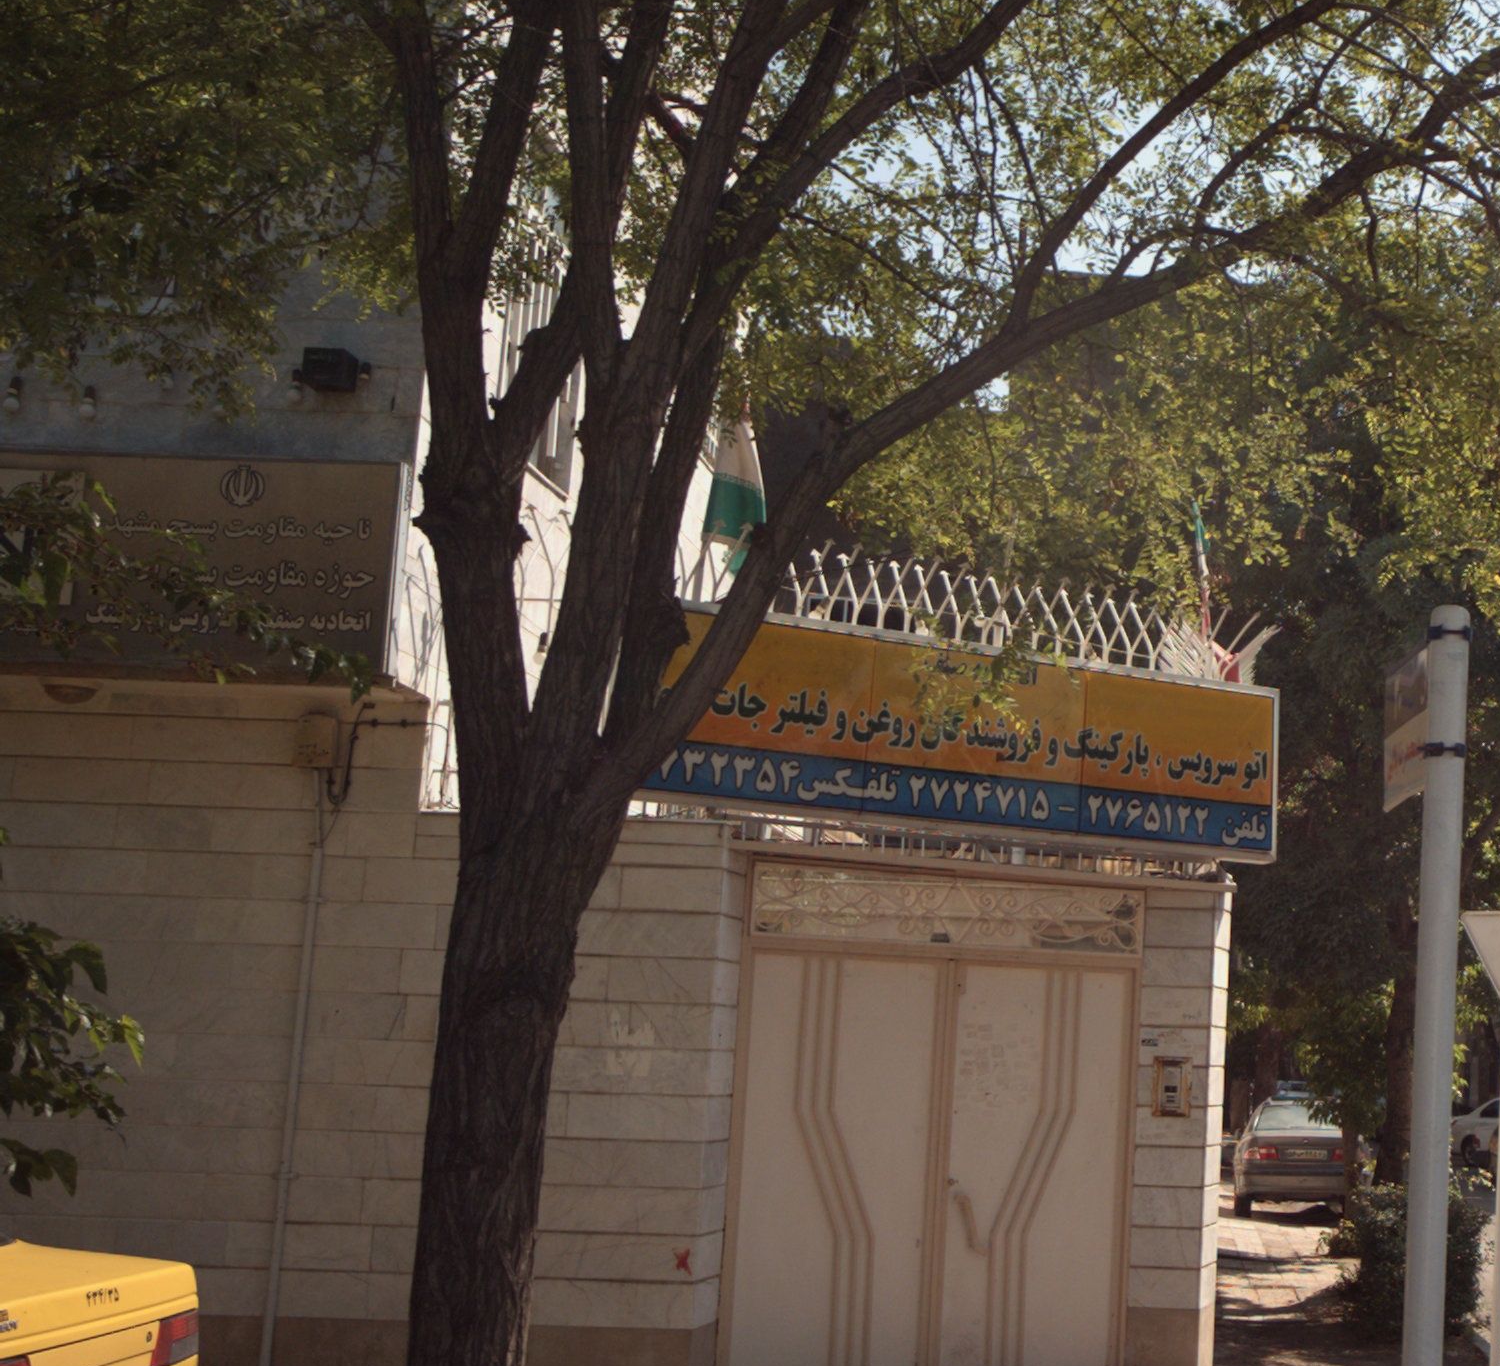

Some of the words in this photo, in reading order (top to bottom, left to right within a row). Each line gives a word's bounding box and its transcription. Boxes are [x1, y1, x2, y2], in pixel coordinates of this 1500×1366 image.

[222, 515, 306, 545] مقاومت
[223, 559, 307, 595] مقاومت
[313, 561, 376, 600] حوزه
[308, 609, 372, 635] اتحادیه
[770, 689, 830, 734] فیلتر
[831, 710, 847, 741] و
[850, 699, 916, 749] روغن
[1045, 736, 1060, 767] و
[1063, 727, 1151, 778] پارکینگ
[1167, 751, 1238, 786] سرویس
[1240, 750, 1268, 790] اتو
[796, 765, 898, 803] تلفکس
[907, 773, 1051, 822] ۲۷۲۴۷۱۵
[1086, 793, 1210, 837] ۲۷۶۵۱۲۲
[1220, 810, 1269, 847] تلفن
